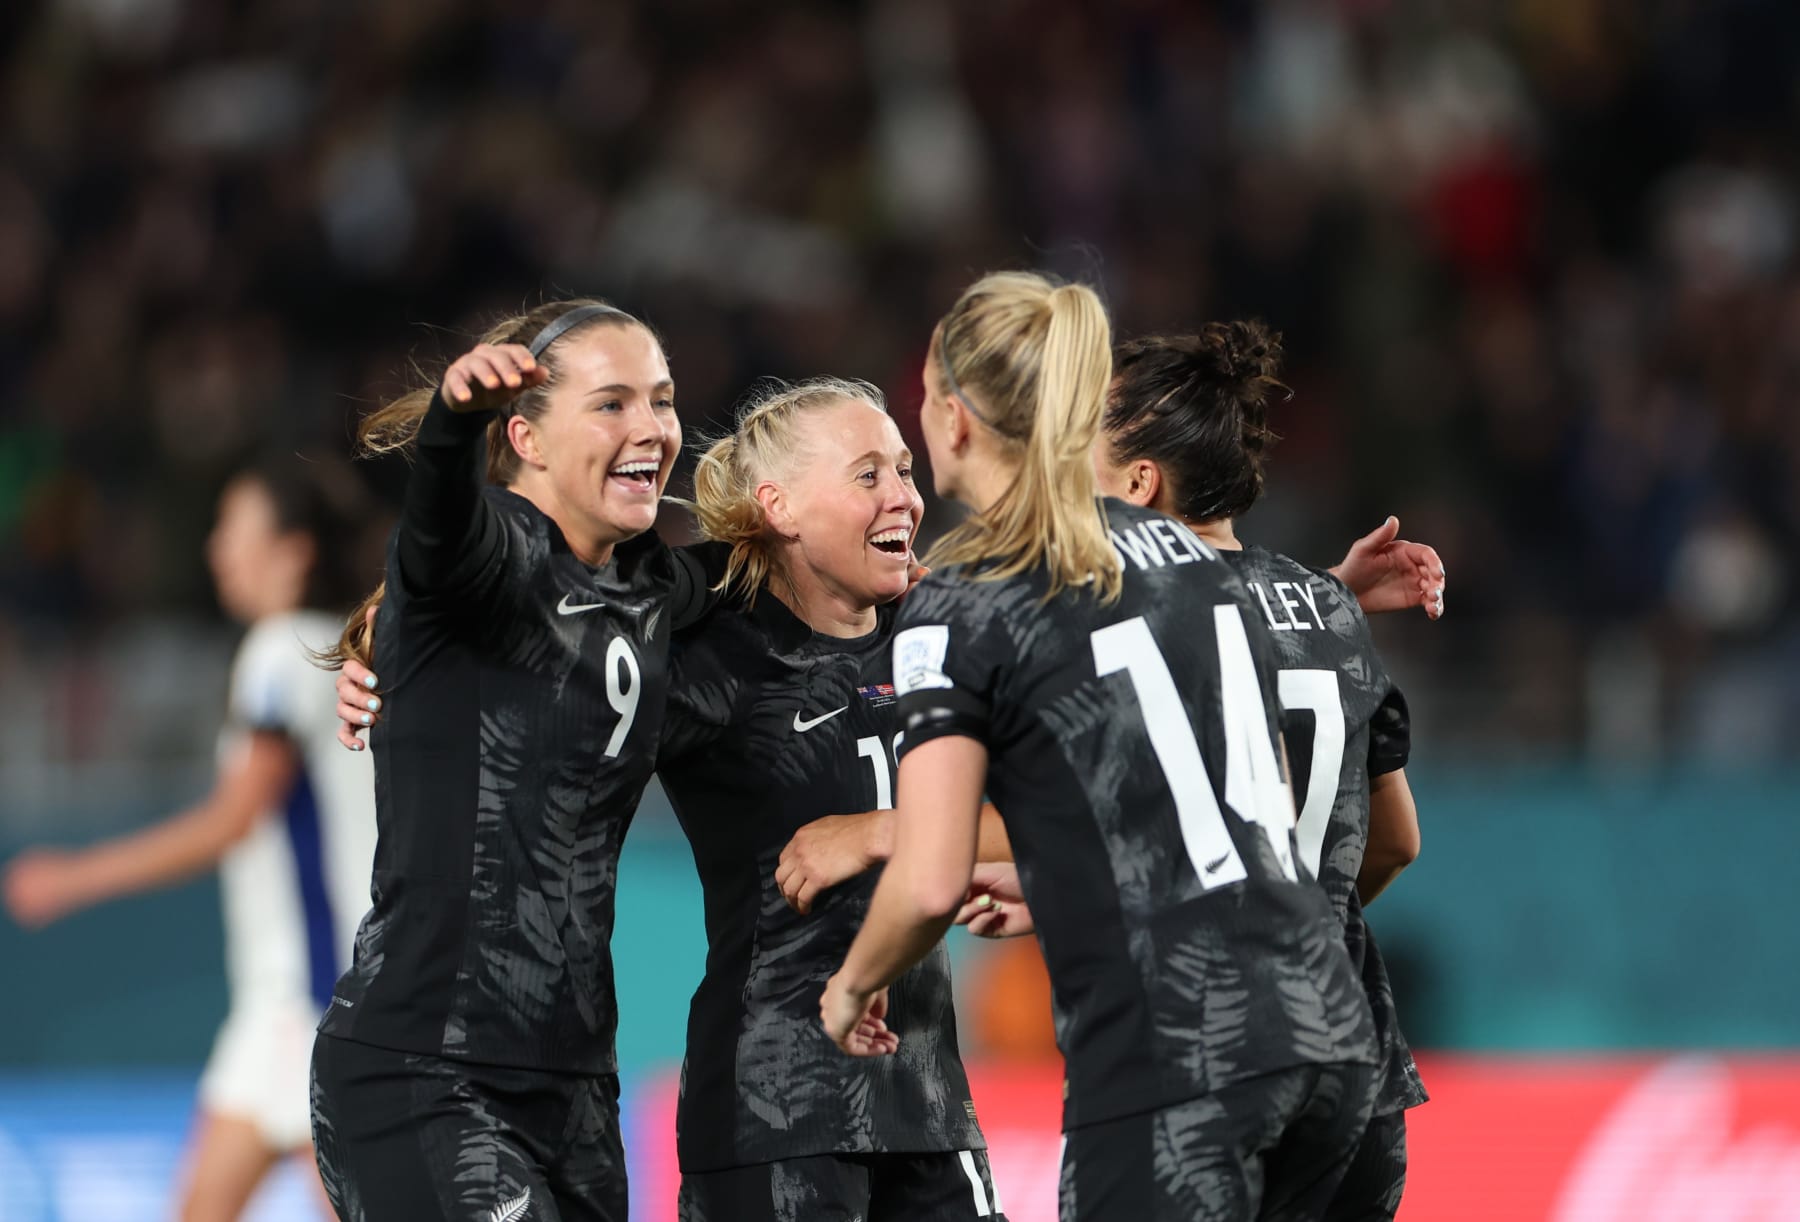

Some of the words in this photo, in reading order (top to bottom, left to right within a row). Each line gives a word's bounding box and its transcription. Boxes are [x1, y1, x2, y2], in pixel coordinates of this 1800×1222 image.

[1246, 582, 1326, 631] LEY
[604, 636, 641, 758] 9
[1090, 604, 1298, 891] 14
[857, 731, 904, 810] 1
[1278, 668, 1346, 882] 7
